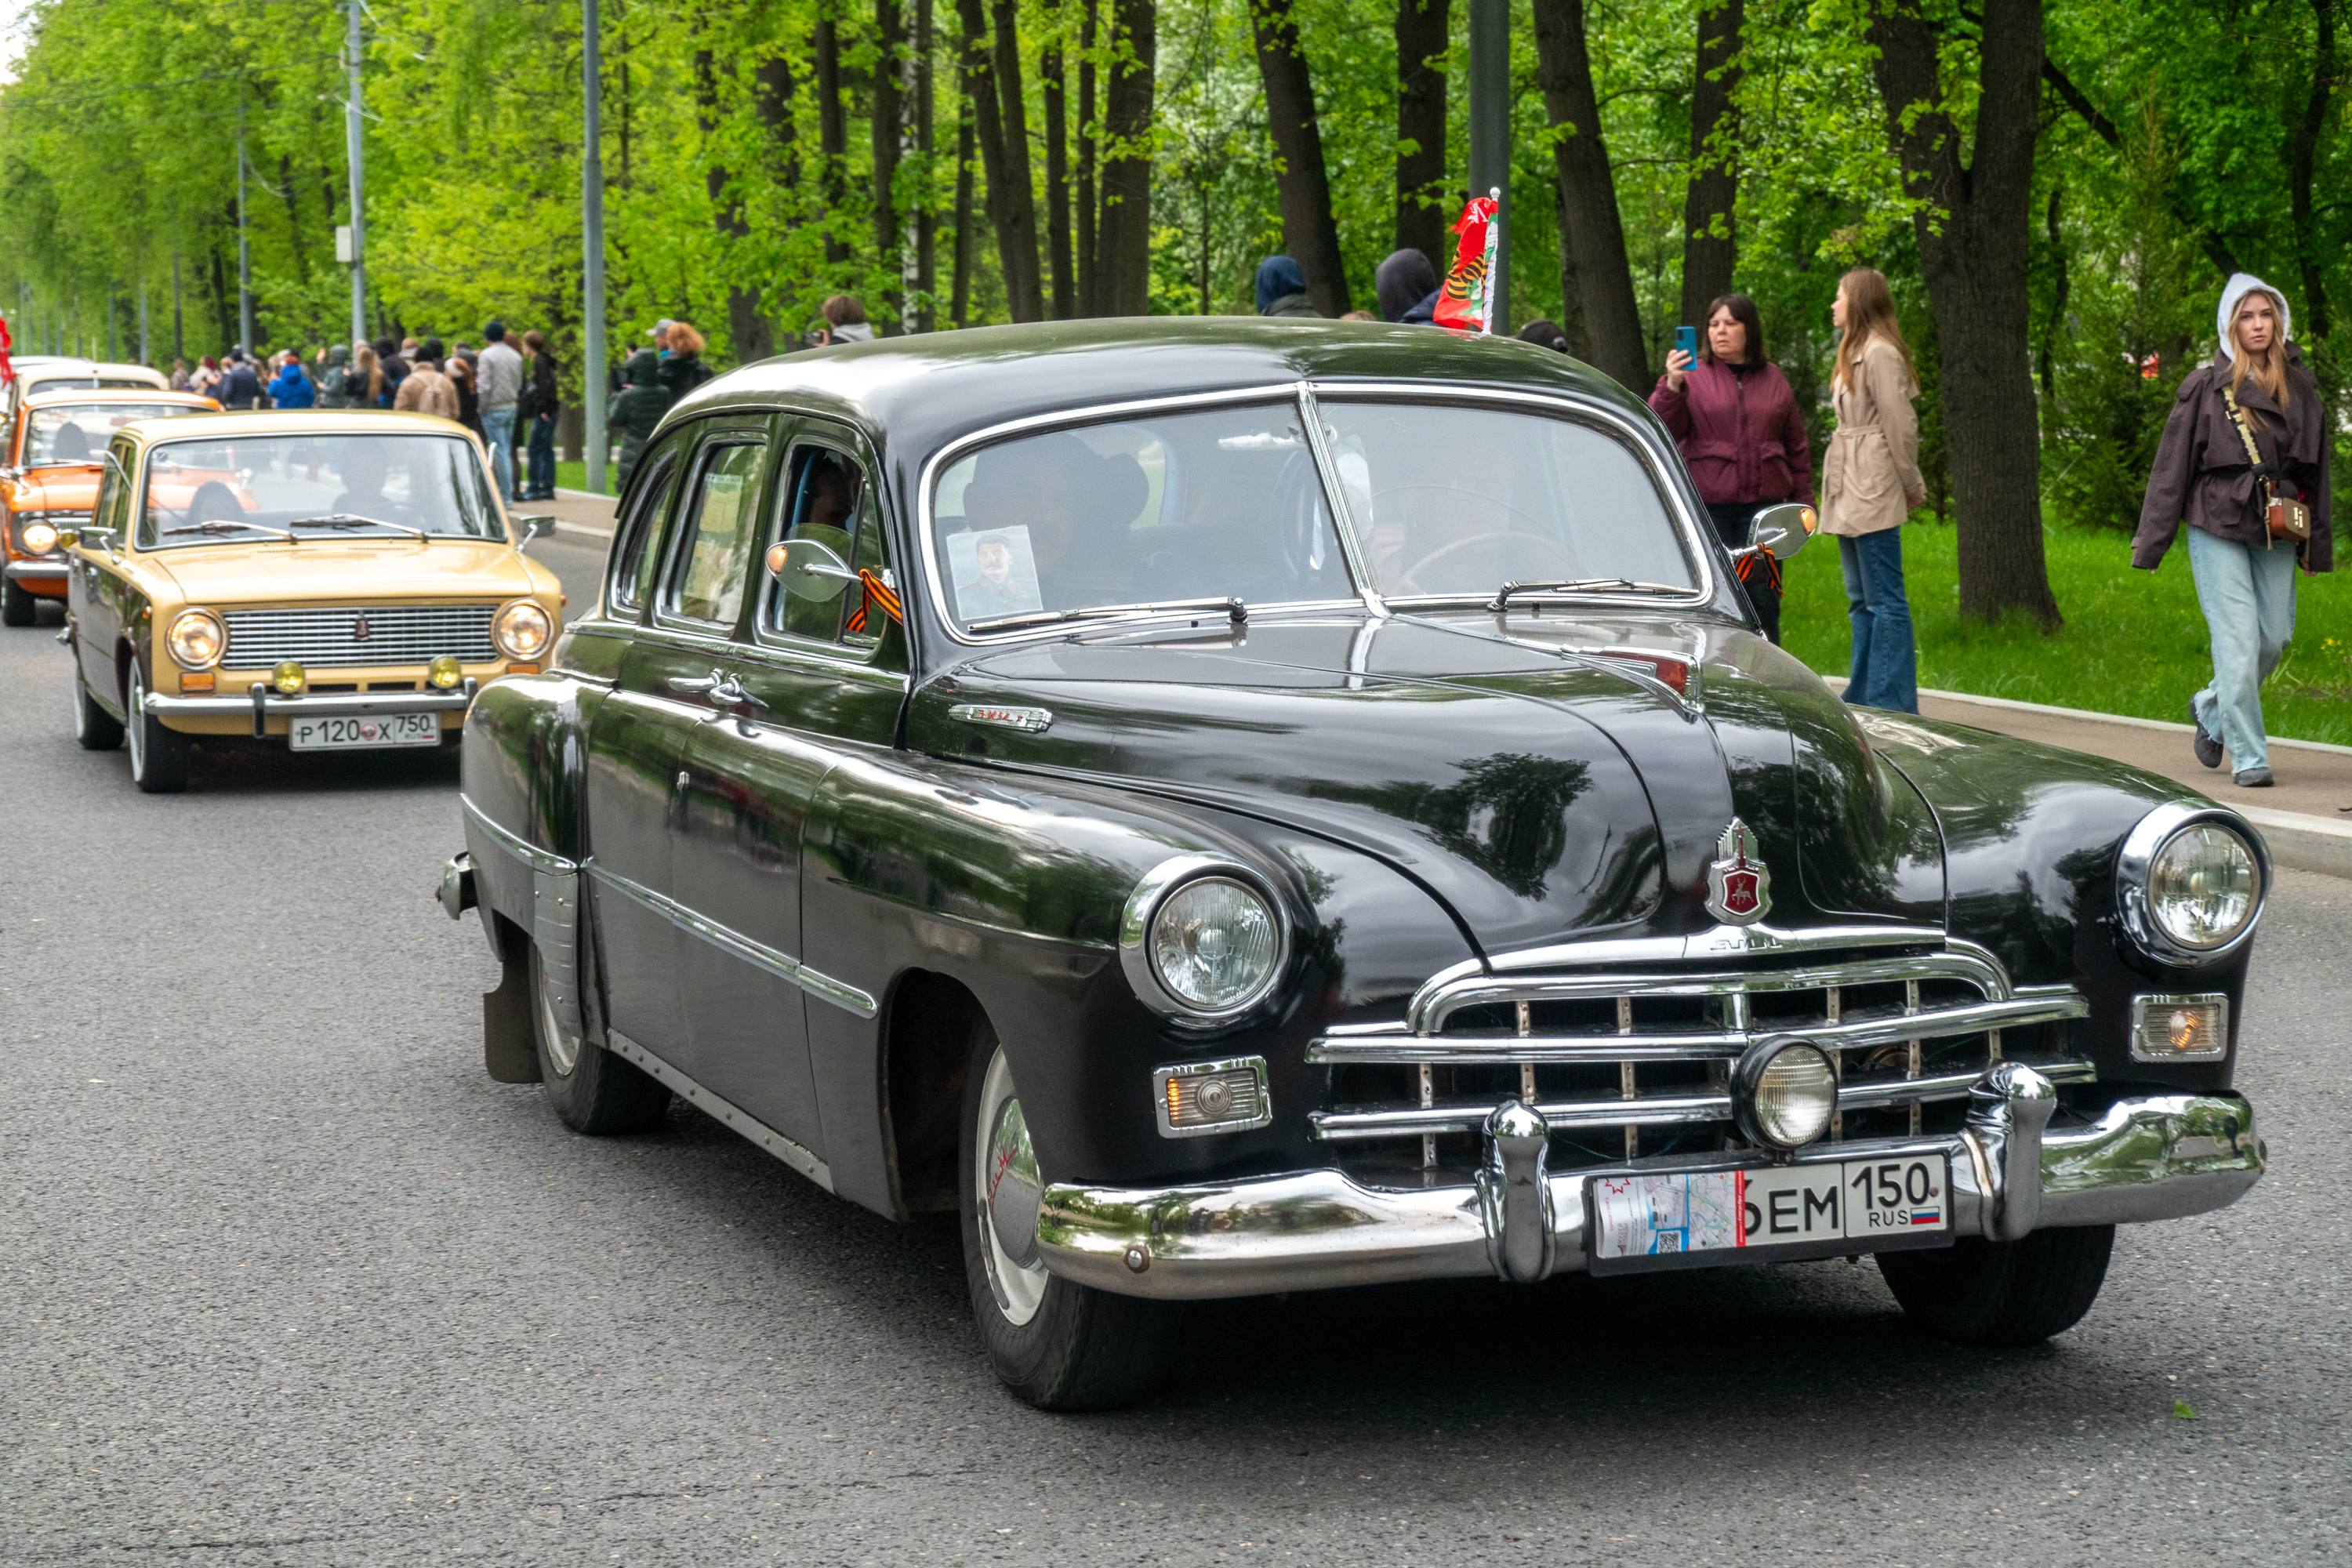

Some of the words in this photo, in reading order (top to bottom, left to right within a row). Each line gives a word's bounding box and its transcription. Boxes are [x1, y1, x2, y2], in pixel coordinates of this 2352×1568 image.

[300, 719, 391, 743] Р120Х
[395, 715, 430, 733] 750
[1851, 1162, 1930, 1210] 150
[1869, 1210, 1909, 1228] RUS
